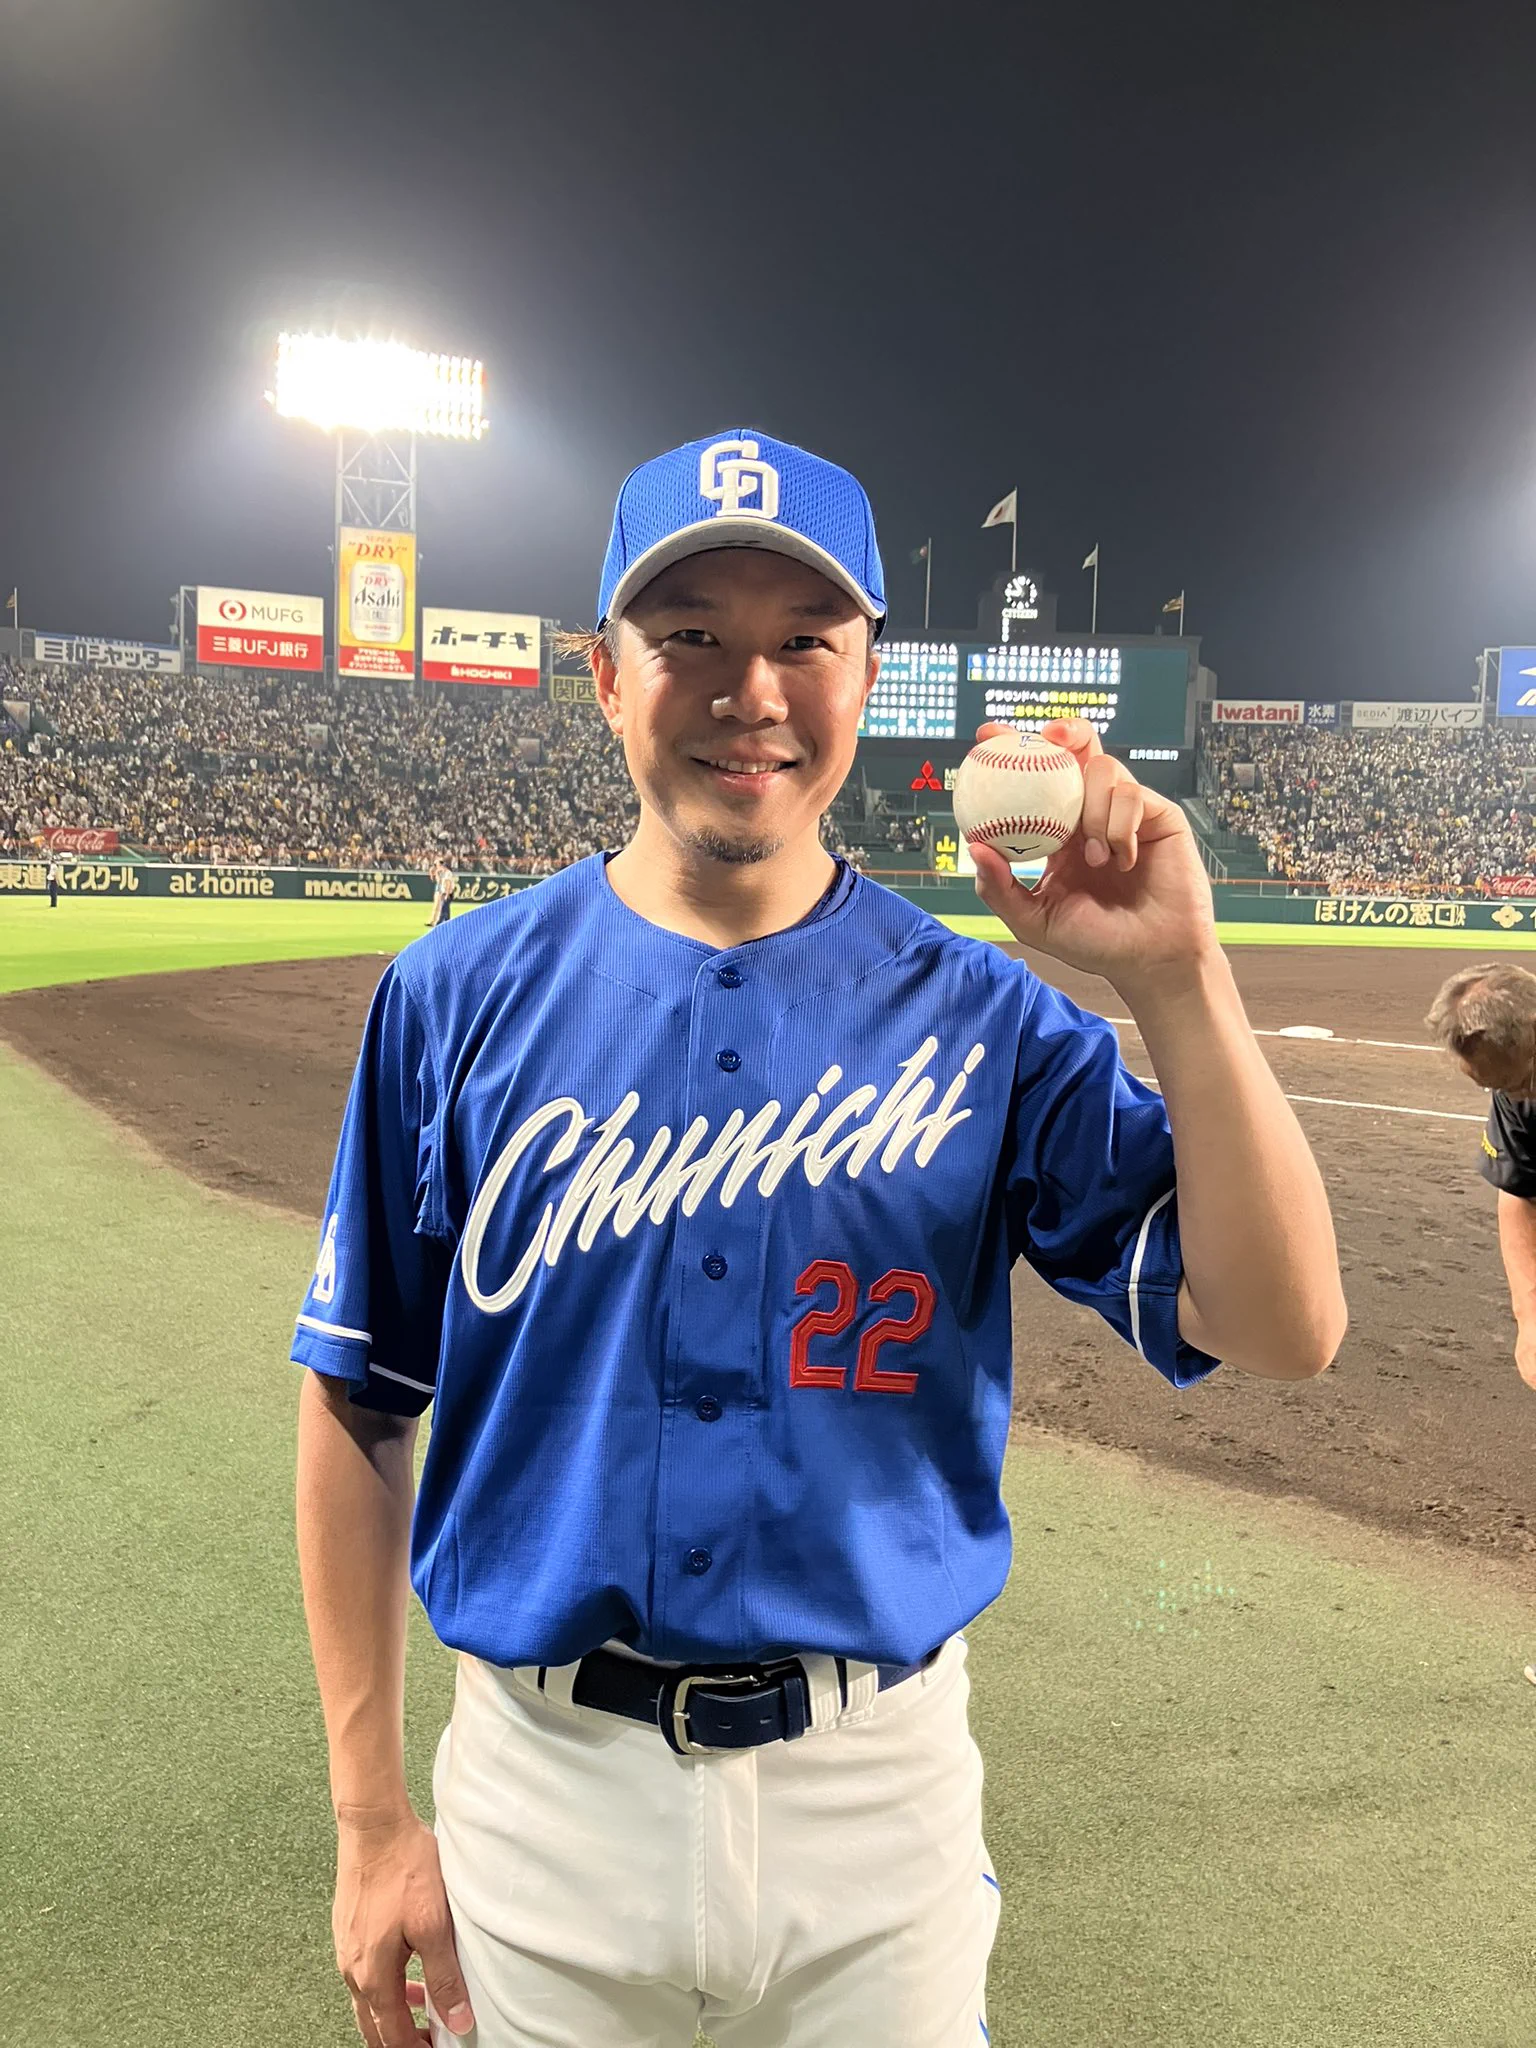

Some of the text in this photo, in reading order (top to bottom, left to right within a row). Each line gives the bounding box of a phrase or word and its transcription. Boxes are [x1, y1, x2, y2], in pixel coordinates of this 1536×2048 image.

[354, 586, 400, 608] Asahi
[251, 606, 304, 623] MUFG
[212, 635, 309, 659] 三菱UFJ銀行
[431, 626, 533, 651] ホーチキ
[43, 640, 173, 669] 三和シャッター
[1217, 704, 1300, 721] Iwatani
[1308, 704, 1336, 718] 水素
[169, 869, 275, 896] at home
[1315, 900, 1456, 927] ほけんの窓口
[461, 1035, 985, 1313] Chunichi
[789, 1259, 937, 1395] 22
